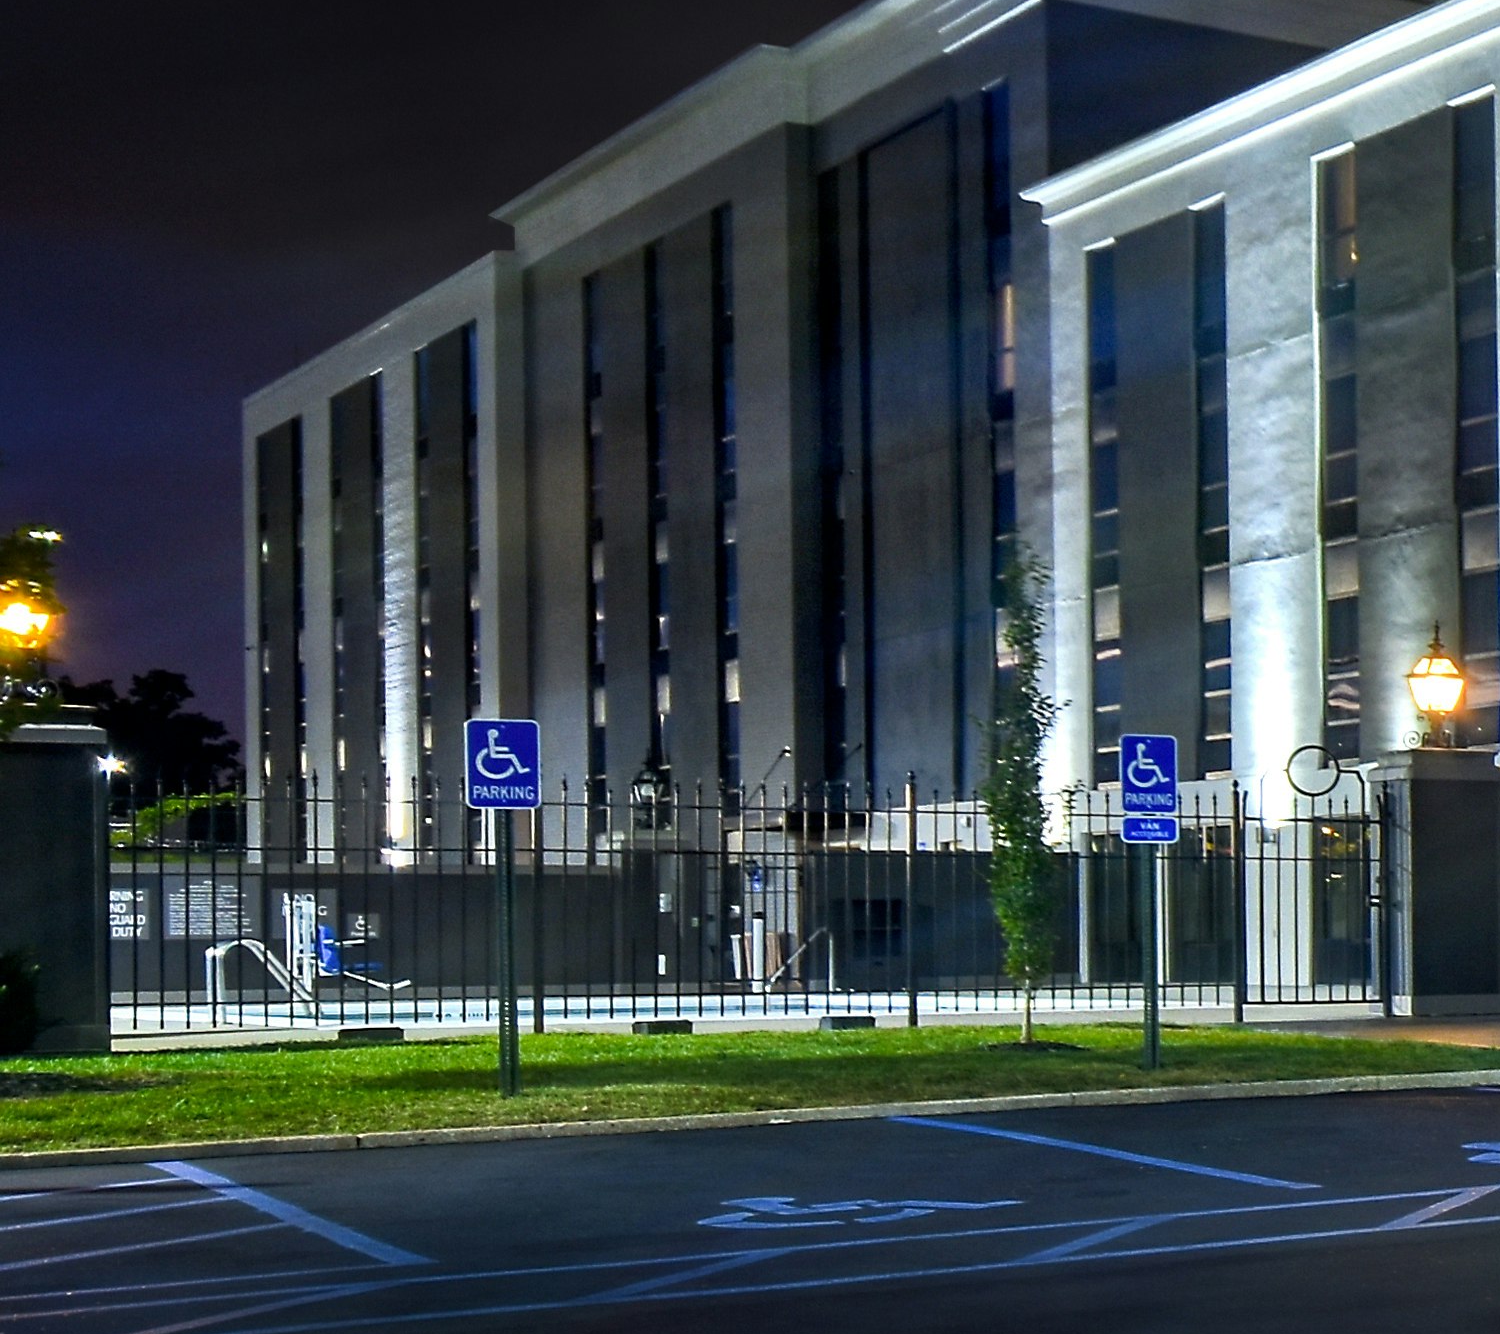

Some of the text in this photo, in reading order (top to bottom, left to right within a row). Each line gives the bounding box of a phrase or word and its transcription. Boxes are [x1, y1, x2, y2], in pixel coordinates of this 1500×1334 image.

[473, 785, 535, 800] PARKING
[1125, 792, 1173, 806] PARKING
[1140, 822, 1160, 830] VAN
